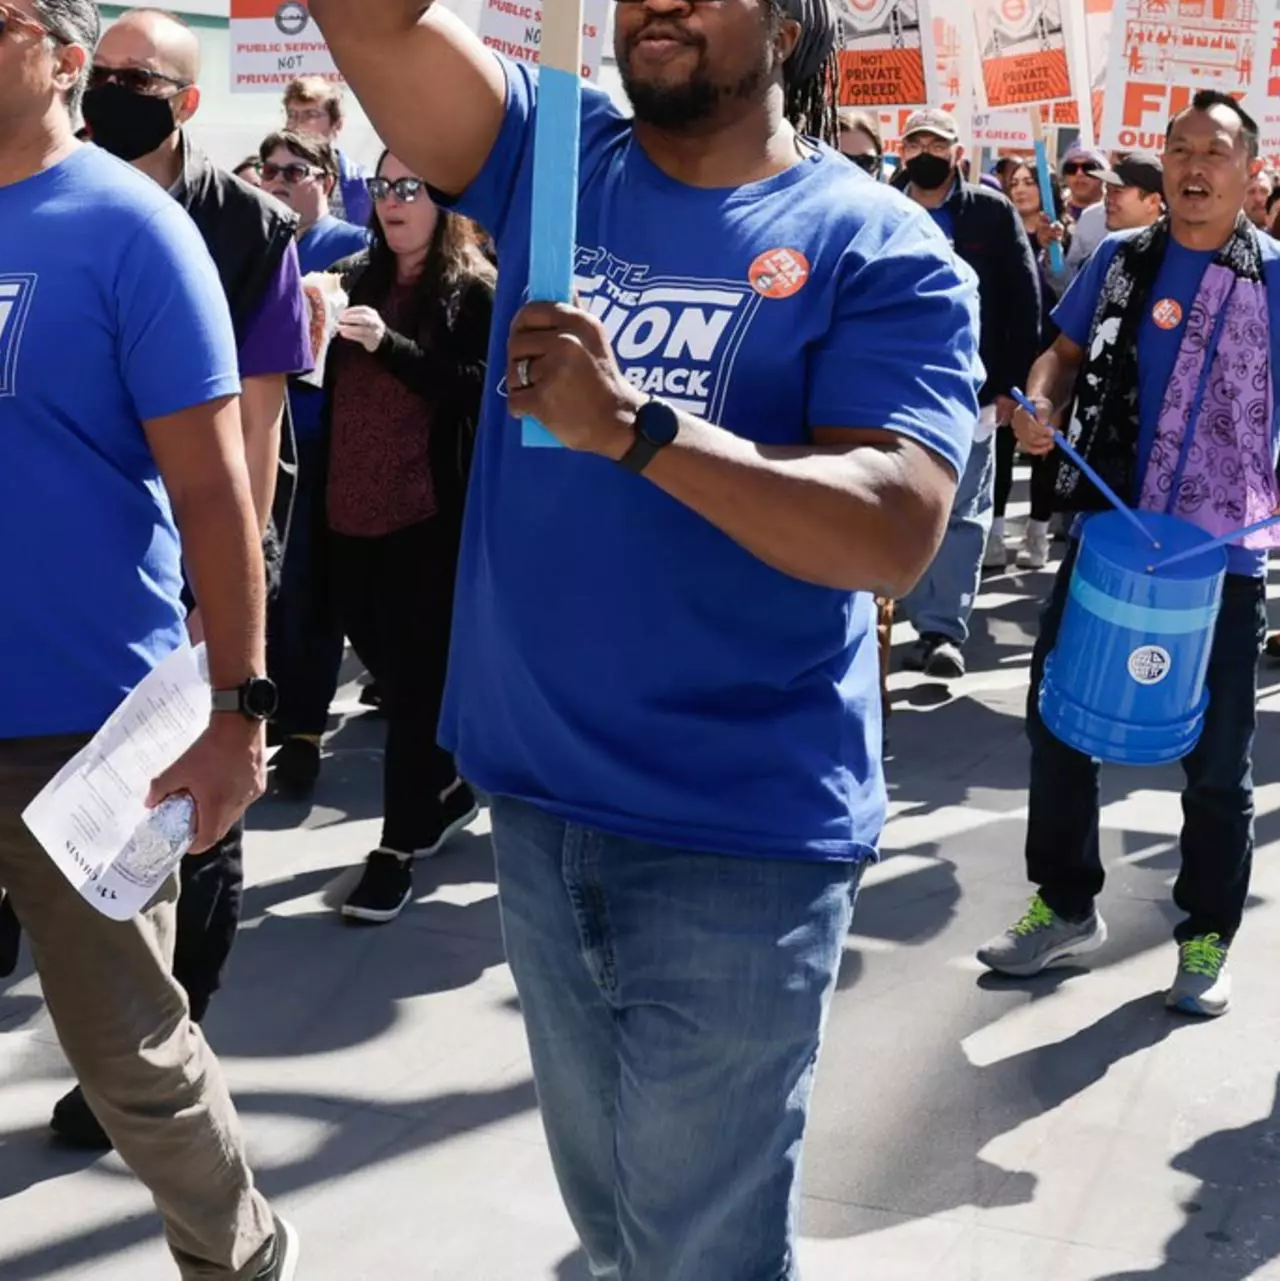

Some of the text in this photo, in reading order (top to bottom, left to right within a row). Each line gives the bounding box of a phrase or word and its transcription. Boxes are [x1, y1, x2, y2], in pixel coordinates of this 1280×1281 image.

[524, 27, 542, 44] NO
[237, 42, 329, 53] PUBLIC SERVI
[483, 35, 540, 63] PRIVATE
[277, 54, 304, 70] NOT
[861, 55, 883, 65] NOT
[846, 67, 901, 81] PRIVATE
[1002, 67, 1049, 83] PRIVATE
[605, 280, 640, 306] THE
